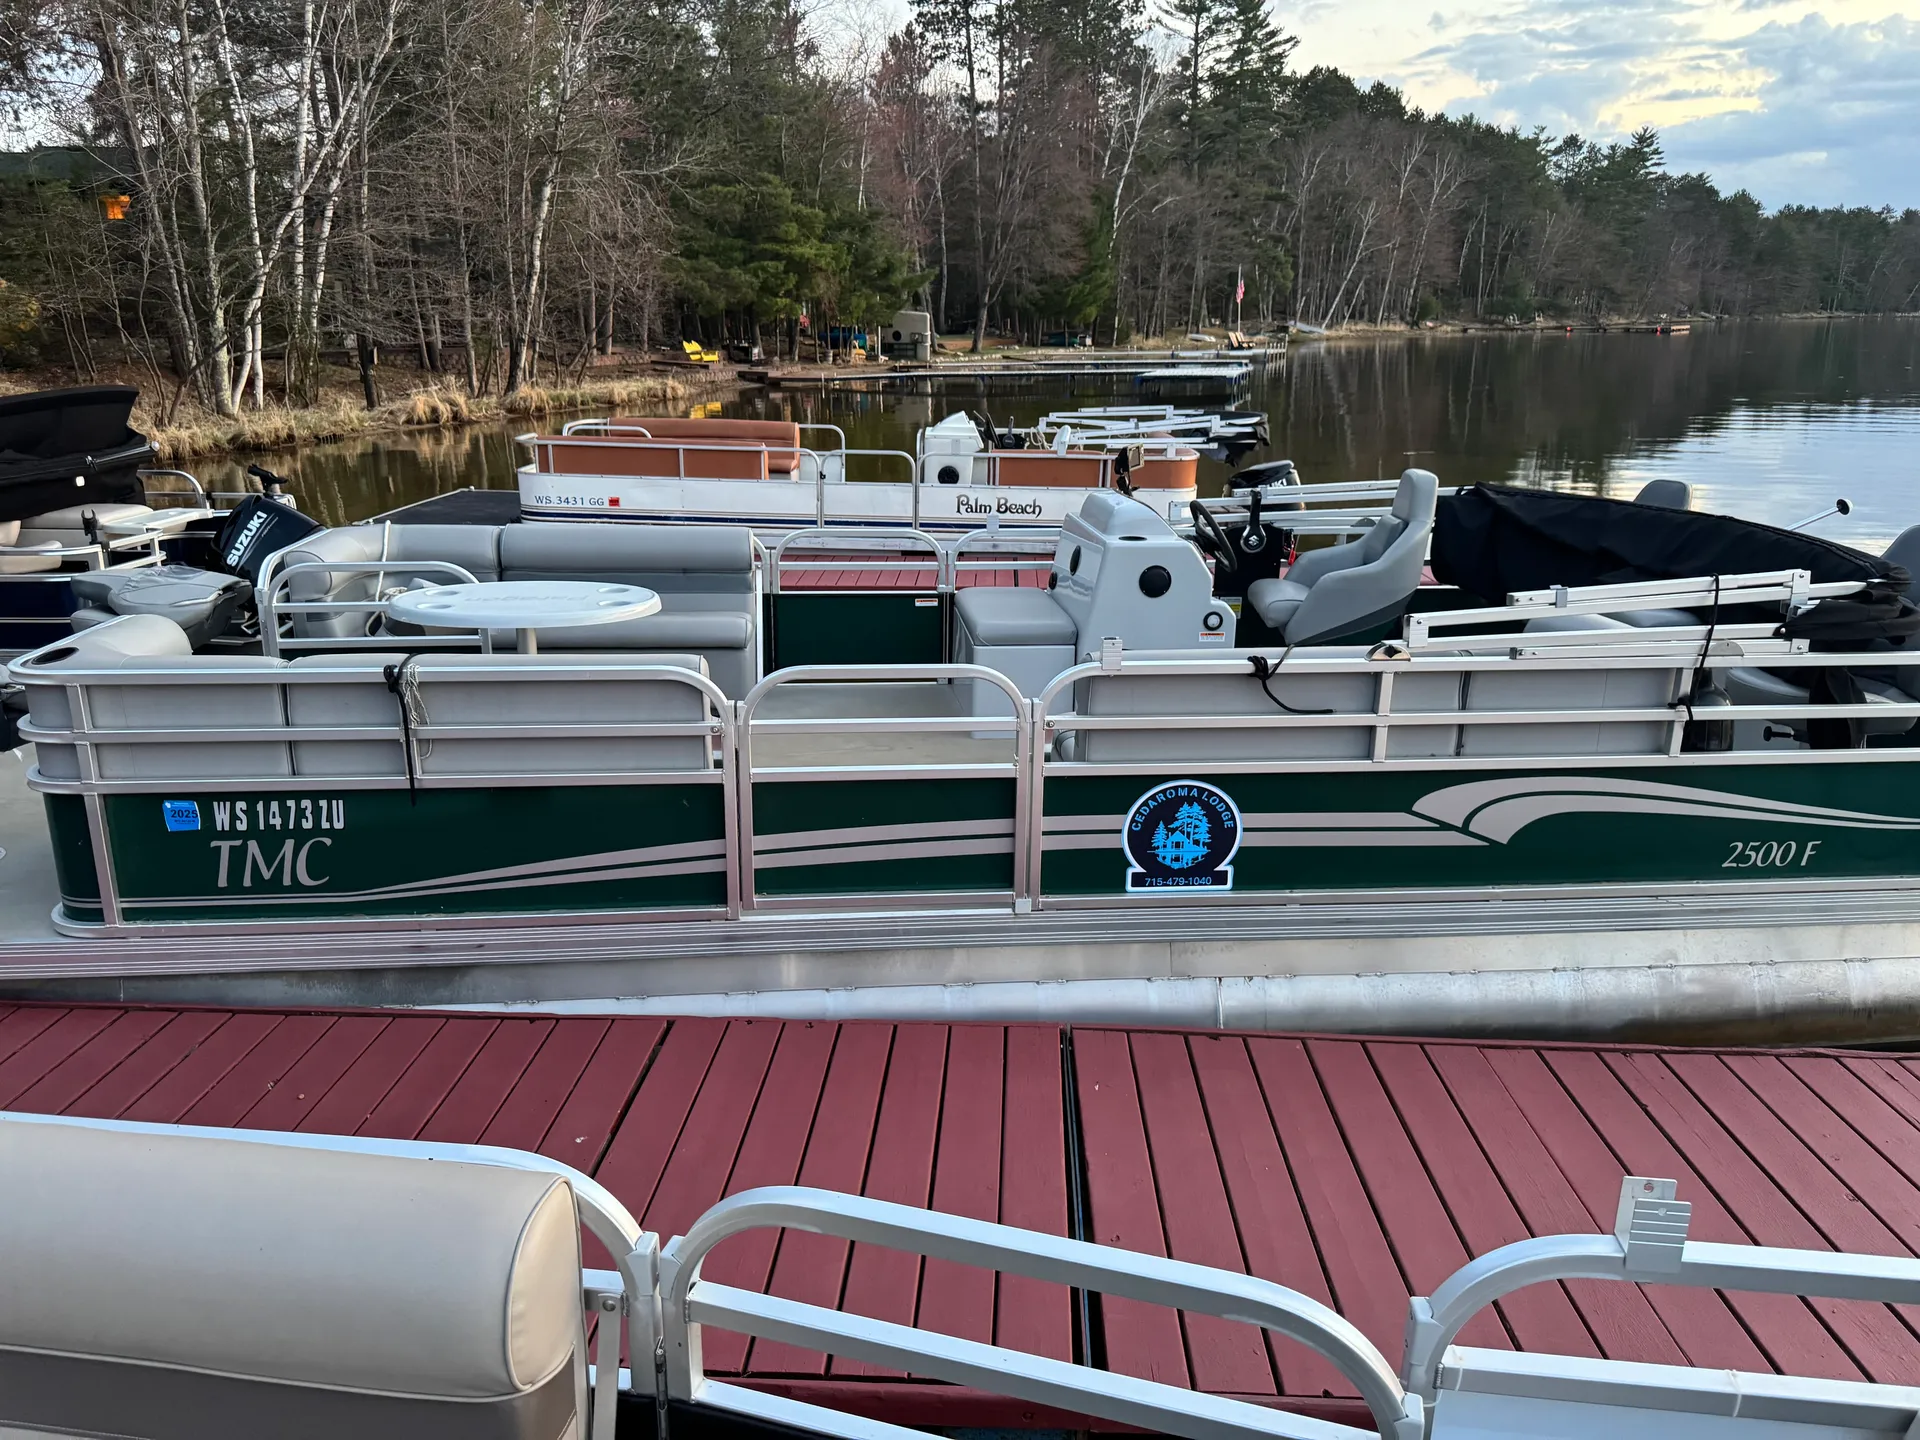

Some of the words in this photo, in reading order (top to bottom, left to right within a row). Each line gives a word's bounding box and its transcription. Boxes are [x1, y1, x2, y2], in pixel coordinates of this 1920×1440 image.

[588, 497, 605, 507] GG
[956, 494, 992, 515] Palm
[996, 496, 1042, 518] Beach
[226, 510, 268, 567] SUZUKI
[170, 808, 199, 819] 2025
[212, 800, 248, 831] WS
[1131, 787, 1199, 831] CEDAROMA
[1201, 791, 1234, 829] LODGE
[209, 836, 333, 888] TMC
[1721, 840, 1797, 868] 2500
[1800, 840, 1823, 867] F
[1145, 876, 1212, 887] 715-479-1040
